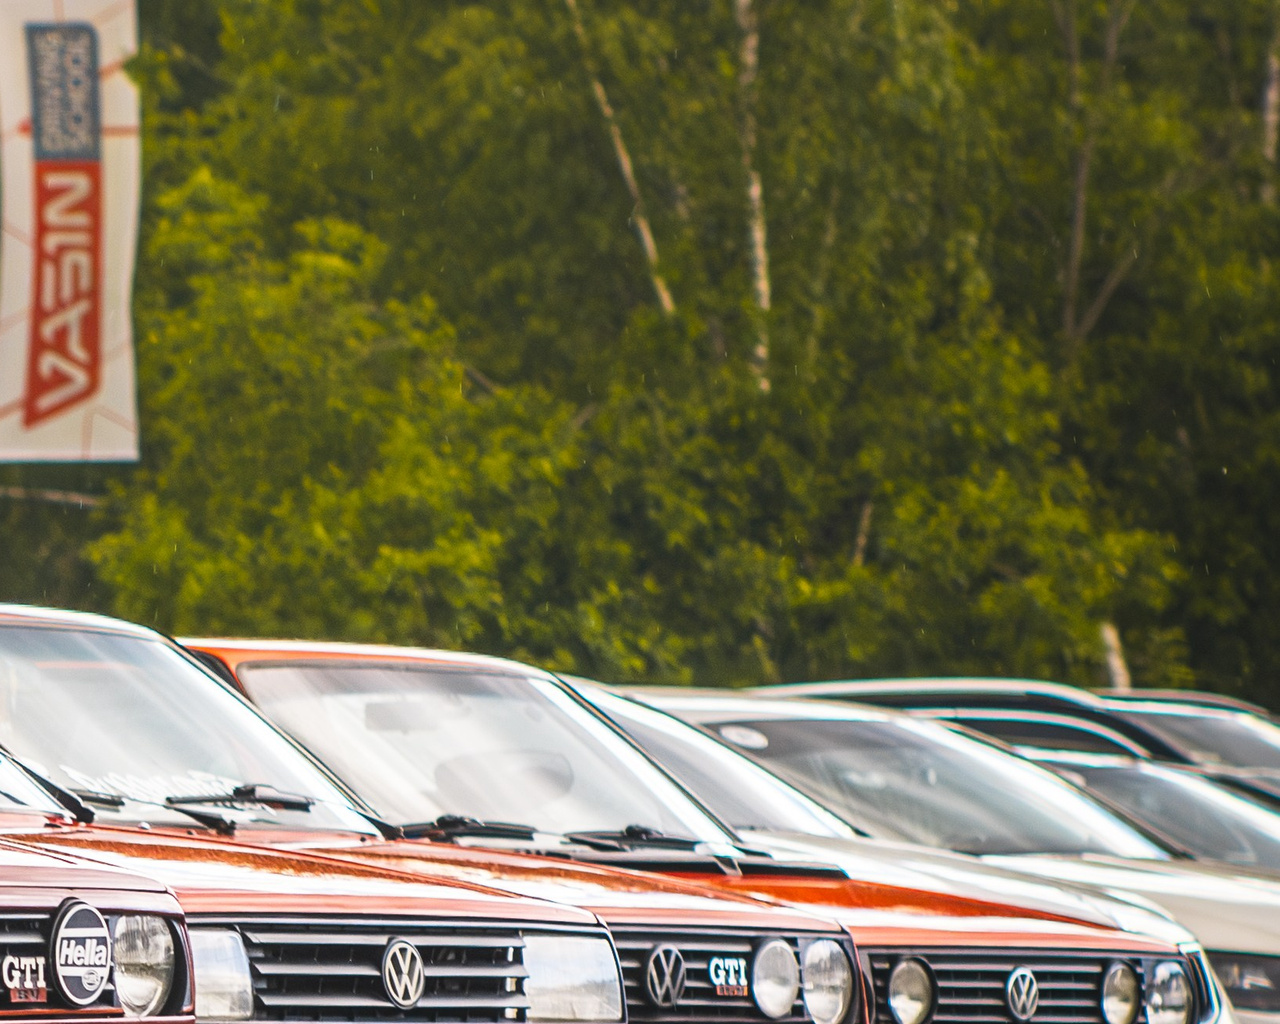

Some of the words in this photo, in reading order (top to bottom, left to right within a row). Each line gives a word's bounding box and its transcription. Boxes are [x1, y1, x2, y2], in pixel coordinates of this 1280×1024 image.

[60, 938, 107, 966] Hella
[2, 955, 47, 989] GTI
[709, 956, 748, 986] GTI
